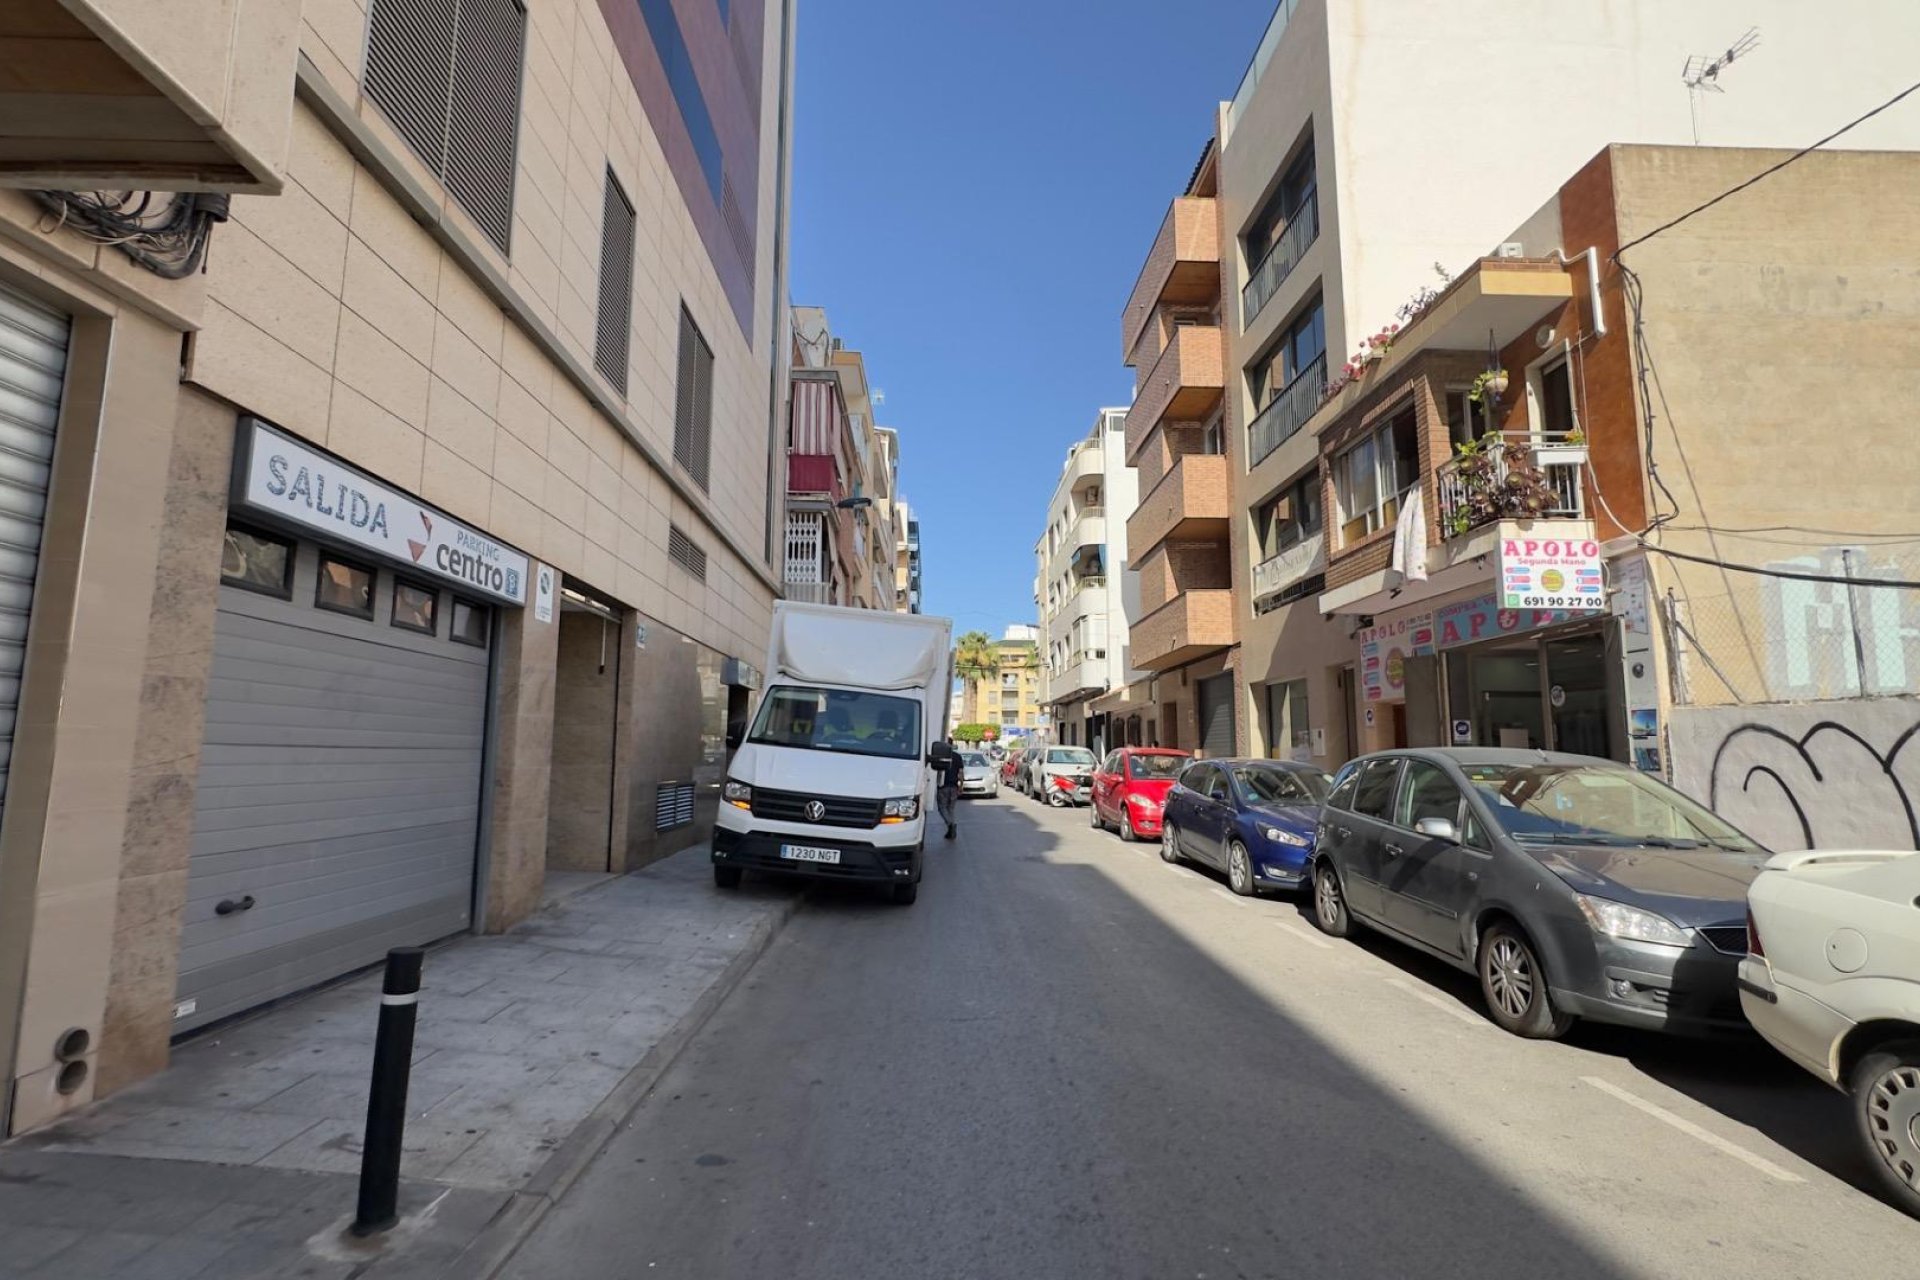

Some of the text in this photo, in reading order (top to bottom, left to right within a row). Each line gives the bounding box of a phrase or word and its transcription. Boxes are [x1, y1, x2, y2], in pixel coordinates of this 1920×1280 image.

[267, 455, 388, 538] SALIDA
[457, 531, 499, 560] PARKING
[1504, 540, 1598, 557] APOLO
[437, 544, 503, 591] centro
[1517, 557, 1558, 566] Segunda
[1524, 597, 1602, 607] 691 90 27 00
[1362, 620, 1405, 643] APOLO
[791, 847, 838, 861] 1230 NGT
